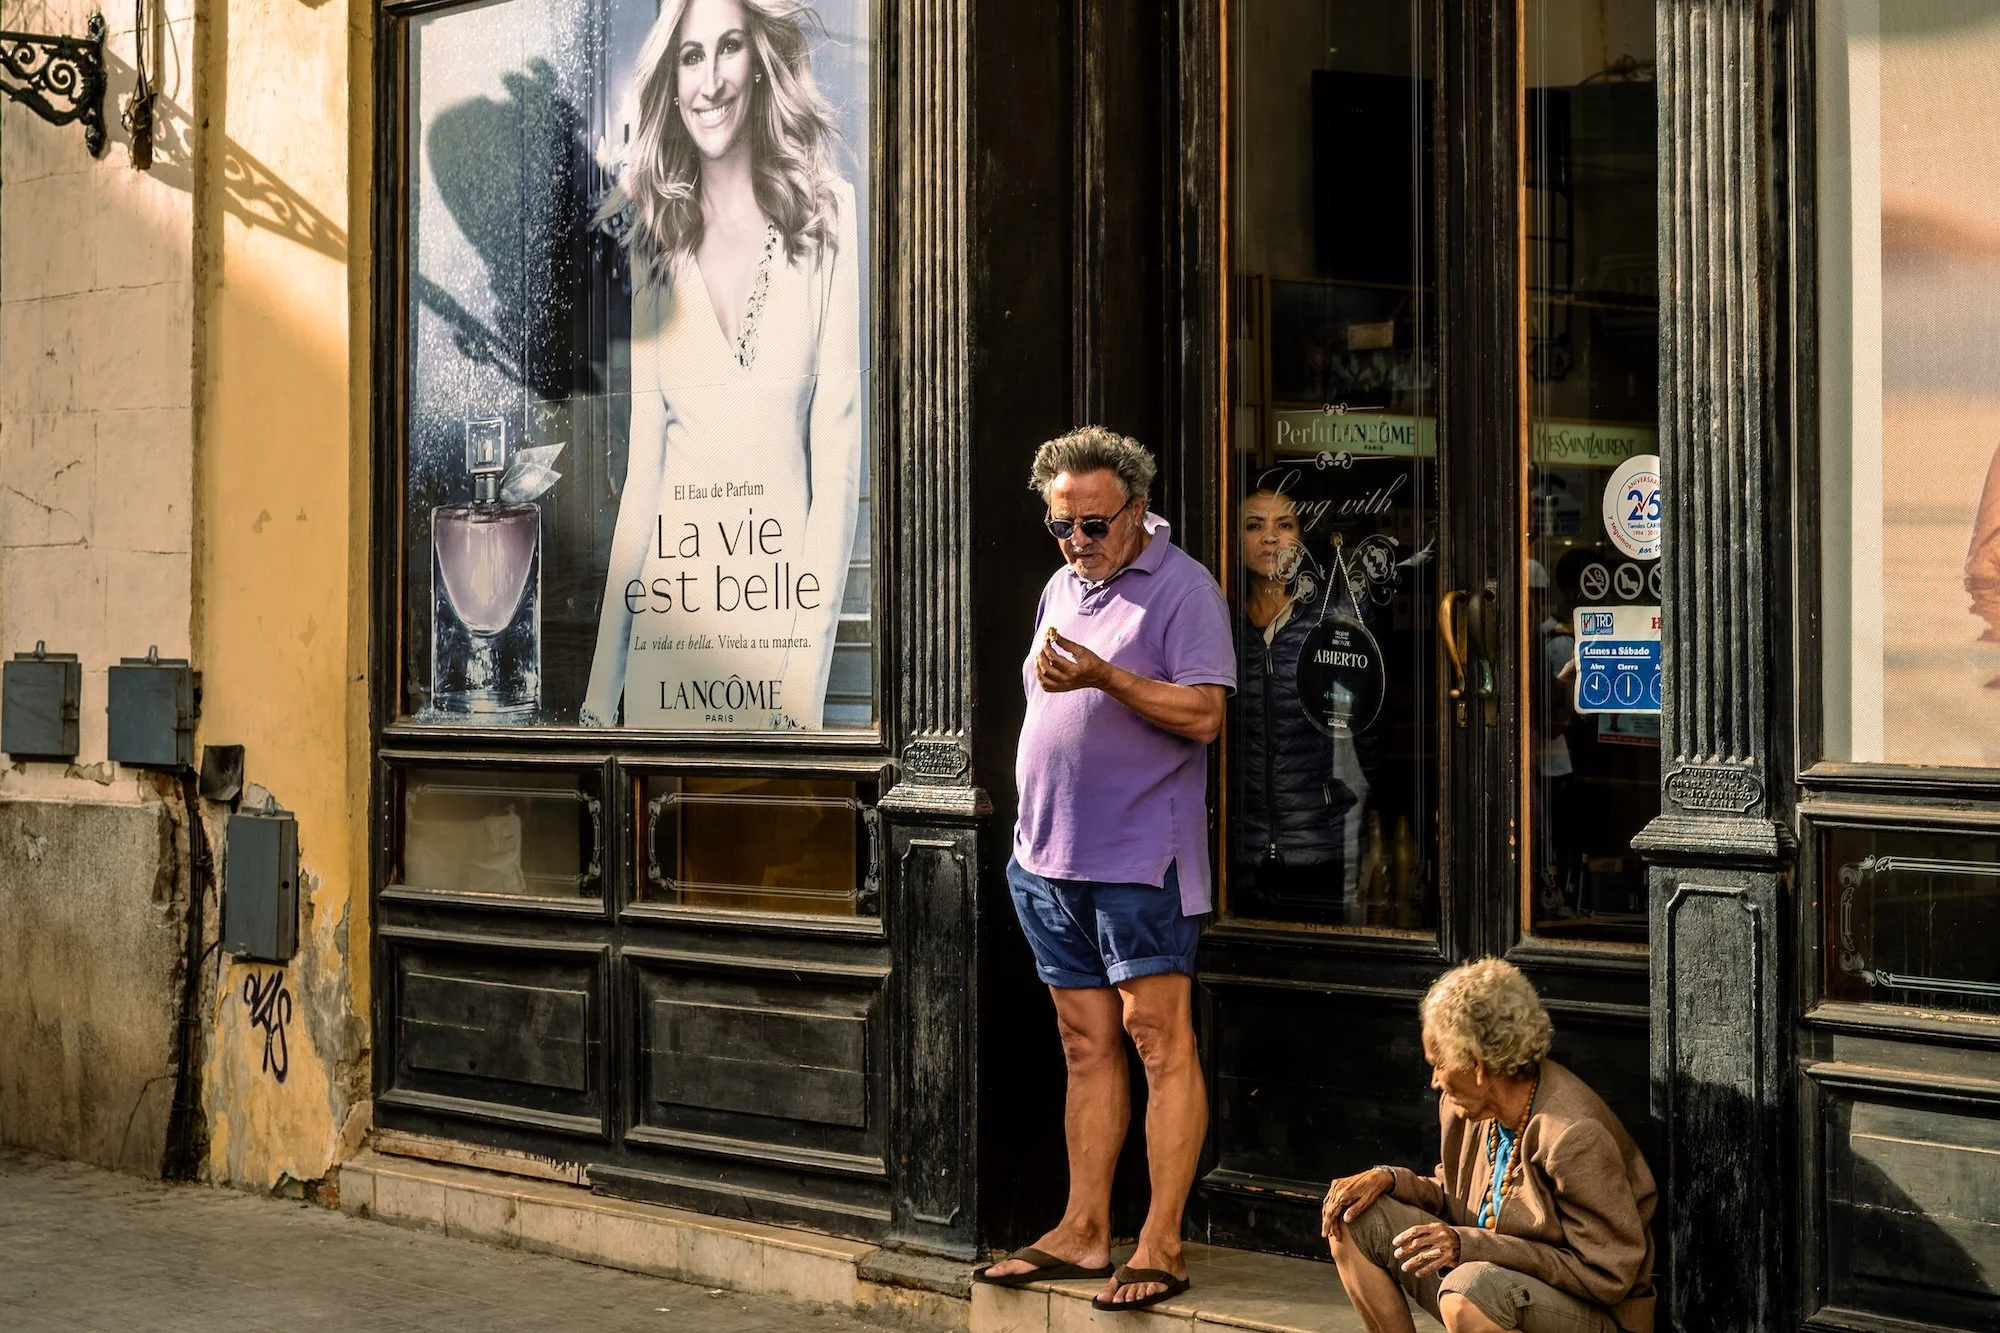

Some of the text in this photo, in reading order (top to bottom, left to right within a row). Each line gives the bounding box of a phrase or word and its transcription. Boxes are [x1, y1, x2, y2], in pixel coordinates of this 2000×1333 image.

[674, 481, 764, 500] El Eau de Parfum
[1627, 489, 1662, 521] 25
[658, 507, 782, 559] La vie
[625, 562, 820, 614] est belle
[1595, 614, 1613, 627] TRD
[634, 636, 646, 651] La
[652, 635, 673, 650] vida
[676, 640, 685, 650] es
[688, 634, 714, 650] bella.
[750, 641, 756, 649] a
[759, 638, 769, 649] tu
[772, 637, 811, 649] manera.
[1585, 647, 1610, 655] Lunes
[1618, 646, 1650, 655] Sábado
[1313, 649, 1368, 669] ABIERTO
[660, 674, 782, 710] LANCÔME
[705, 714, 734, 723] PARIS
